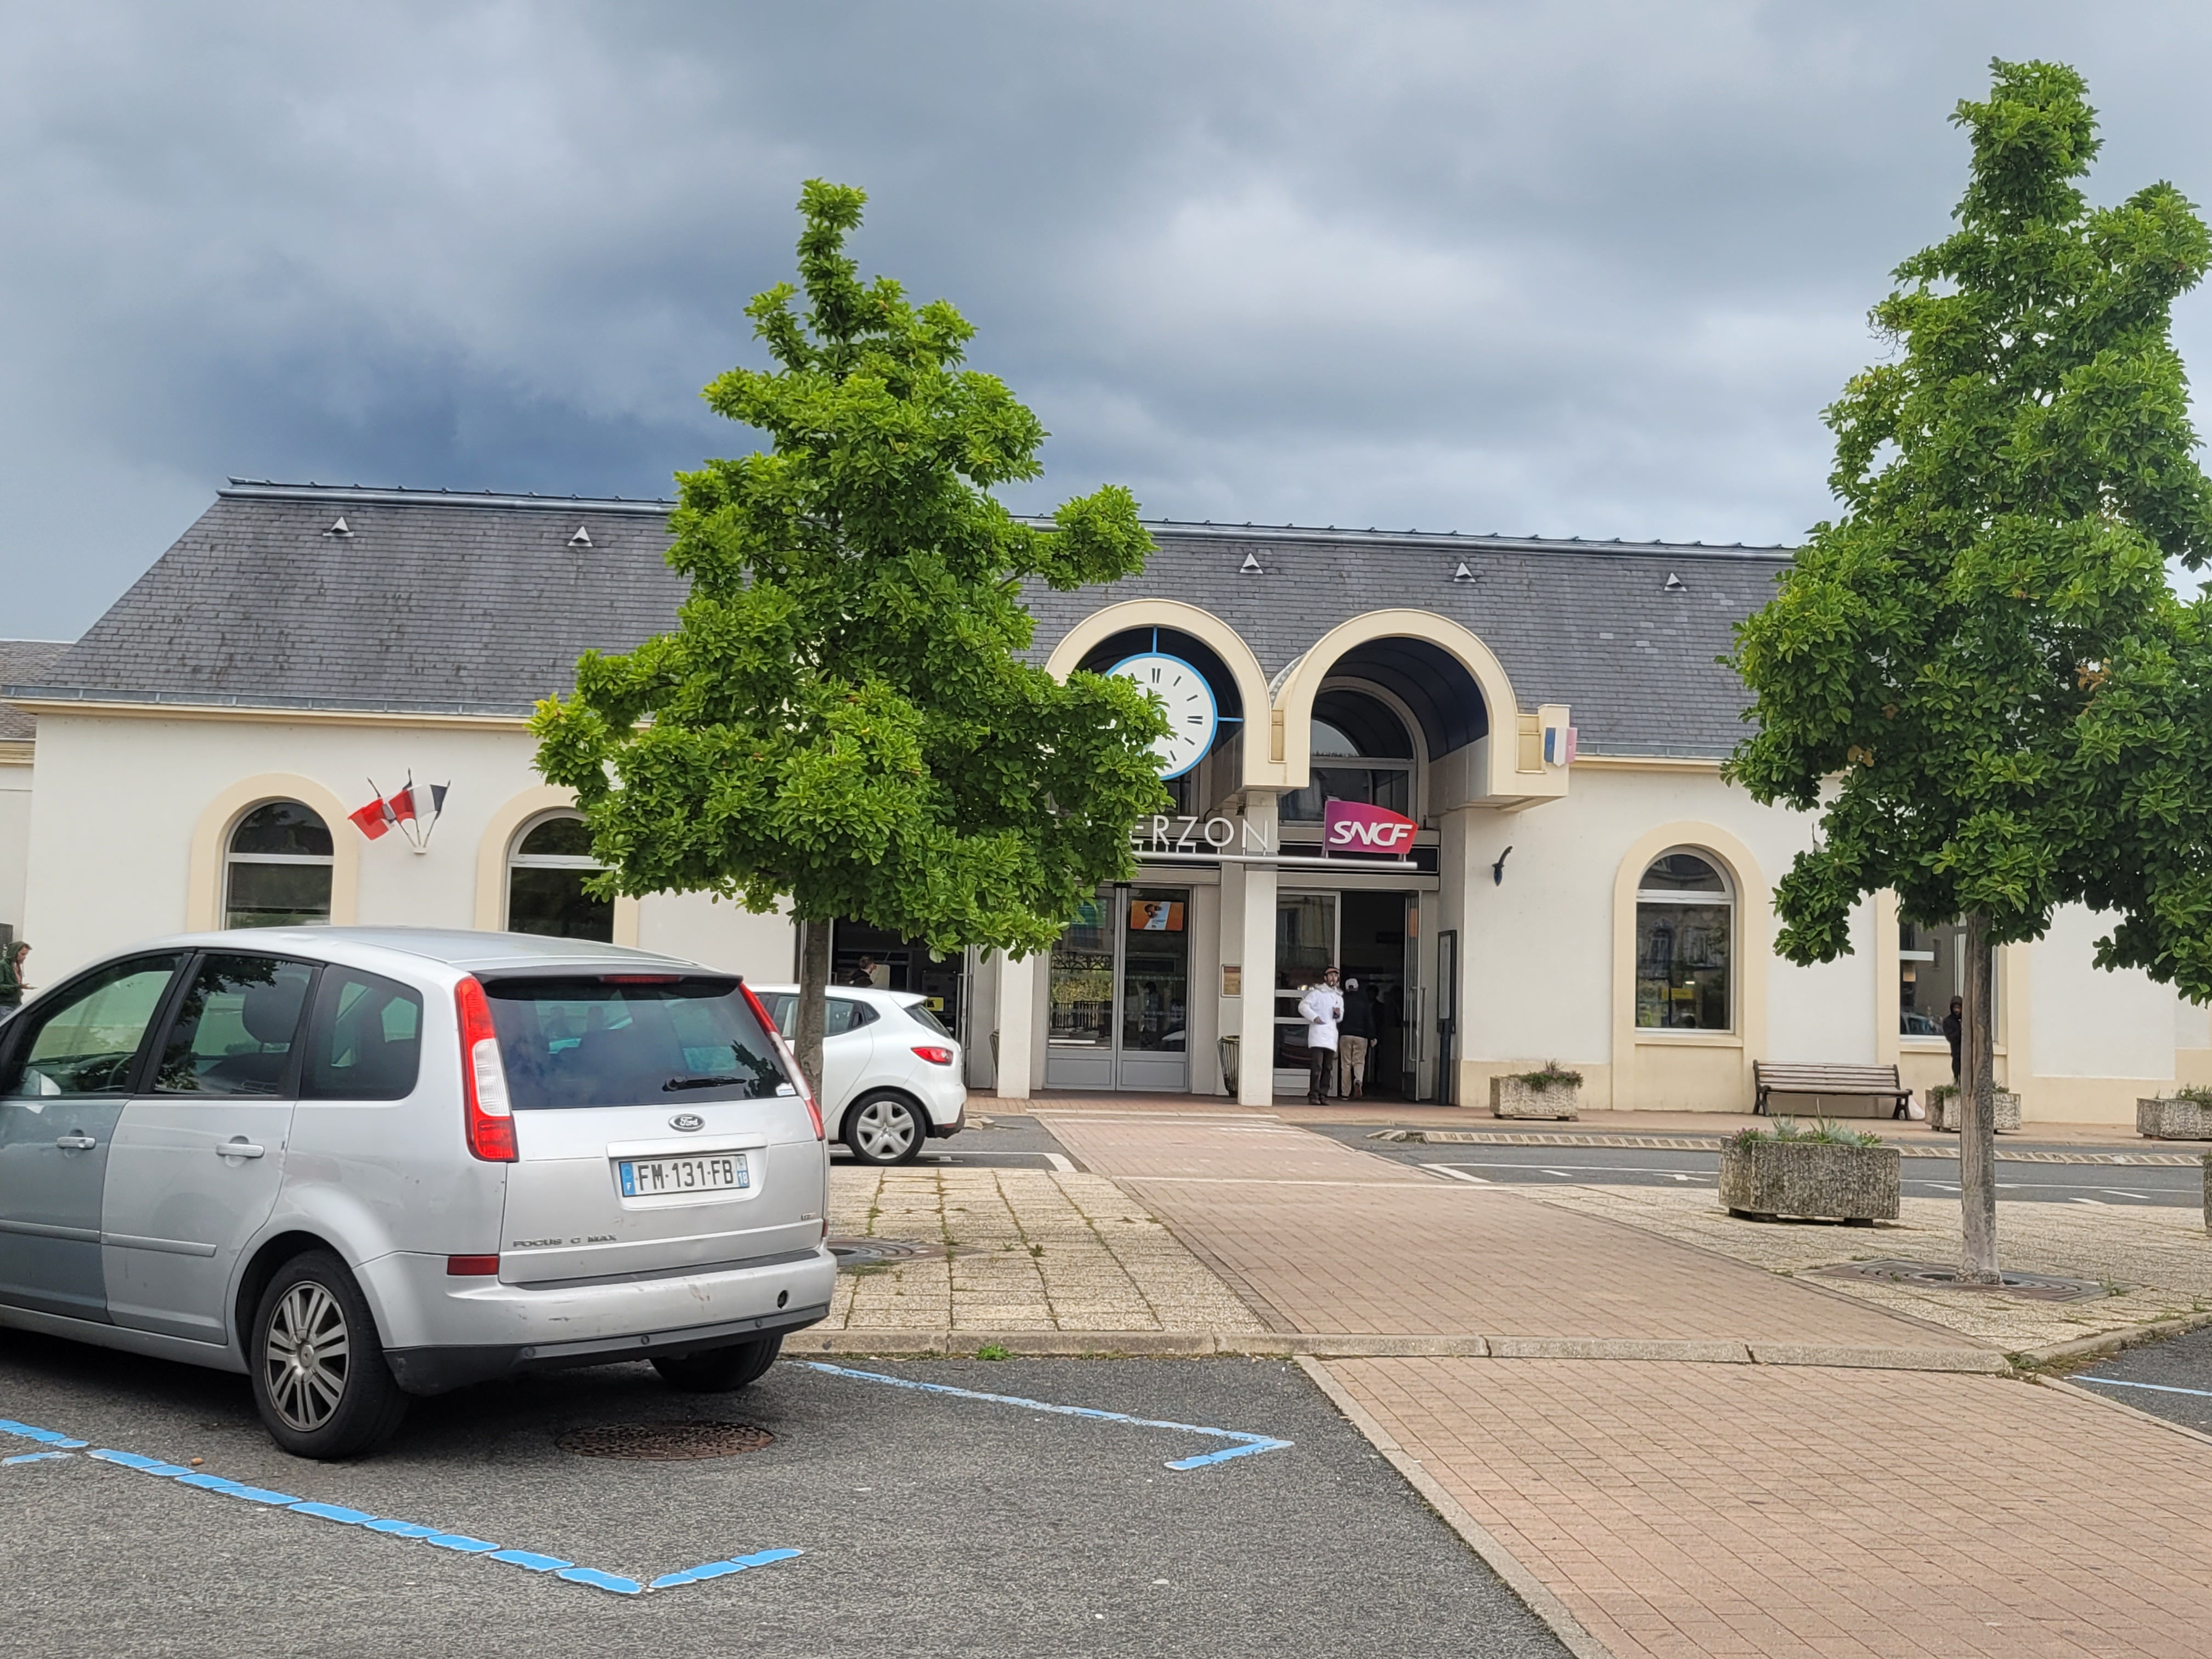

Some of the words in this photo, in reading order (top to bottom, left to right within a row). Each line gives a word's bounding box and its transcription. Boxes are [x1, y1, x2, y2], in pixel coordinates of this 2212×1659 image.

[1129, 814, 1269, 850] ERZON
[1329, 821, 1413, 846] SNCF
[680, 1116, 698, 1126] Ford
[738, 1172, 748, 1185] 18
[513, 1239, 562, 1247] FOCUS
[588, 1234, 617, 1243] MAX
